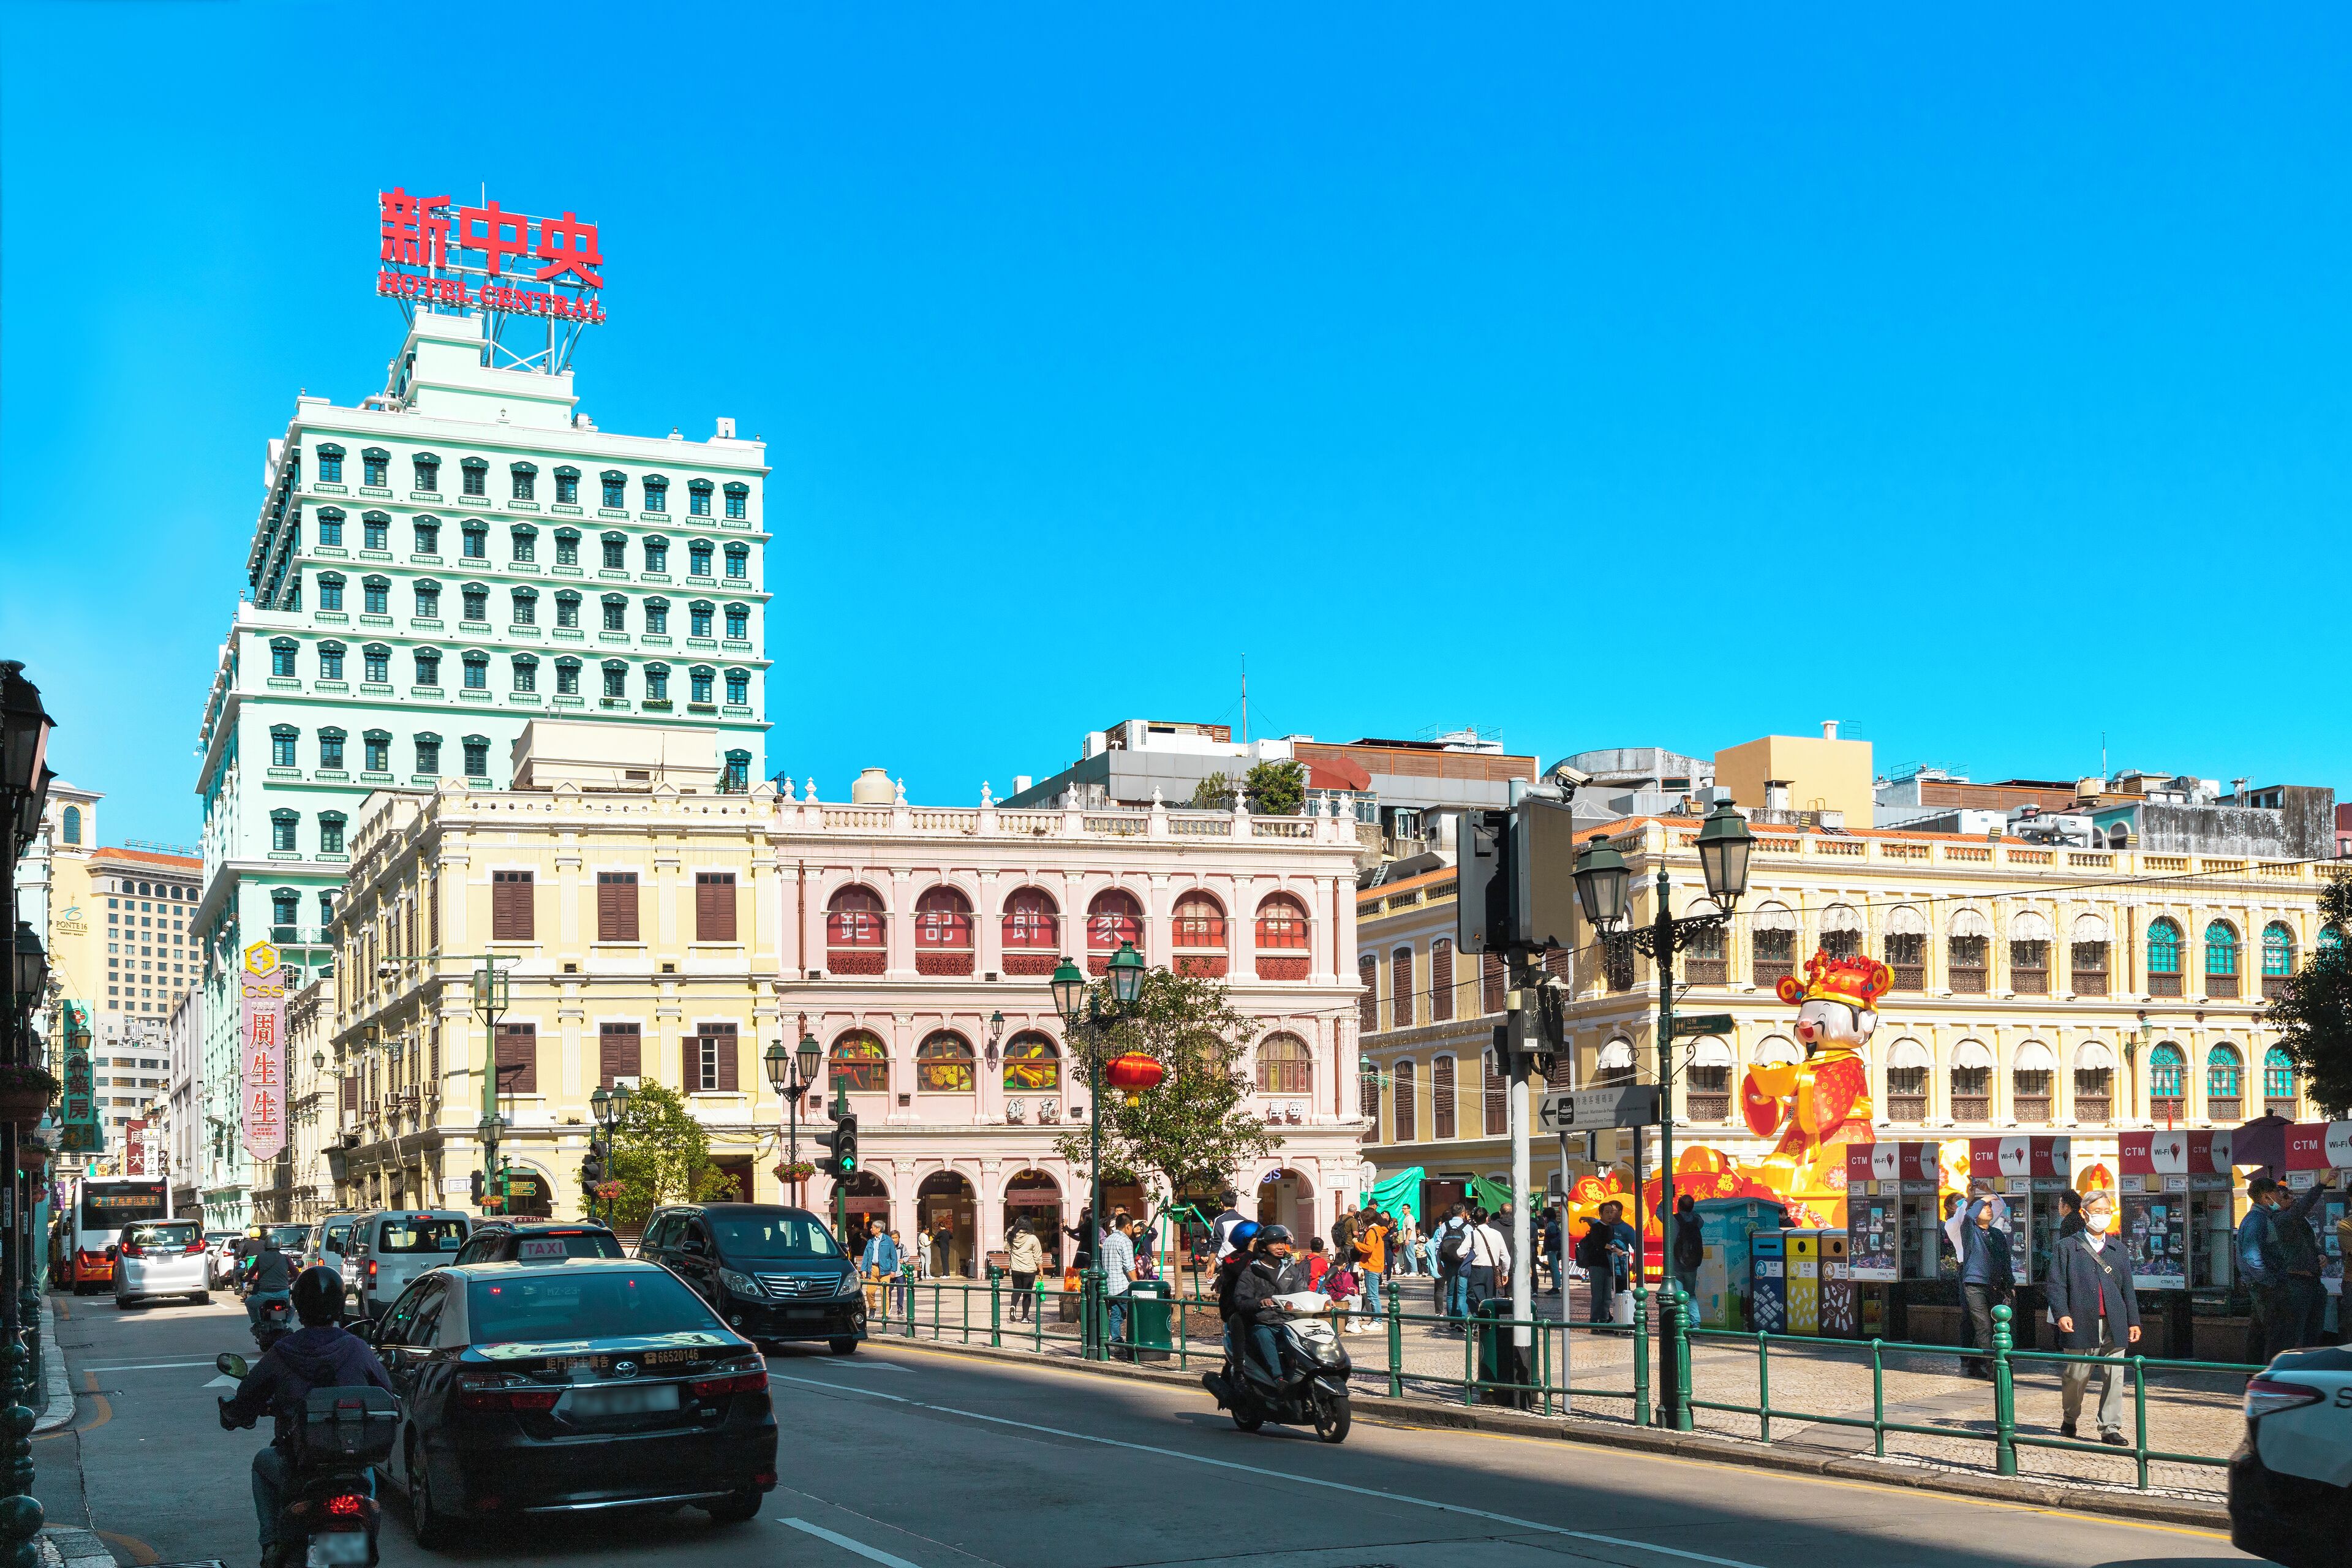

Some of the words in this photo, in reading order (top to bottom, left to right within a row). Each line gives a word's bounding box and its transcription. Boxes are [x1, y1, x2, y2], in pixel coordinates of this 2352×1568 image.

[380, 187, 603, 289] 新中央
[377, 271, 473, 304] HOTEL
[479, 284, 606, 321] CENTRAL
[56, 921, 80, 929] PONTE
[242, 985, 284, 998] CSS
[249, 1012, 278, 1125] 周生生
[2125, 1147, 2145, 1156] CTM
[2293, 1140, 2318, 1150] CTM
[1852, 1156, 1868, 1165] CTM
[1975, 1152, 1993, 1161] CTM
[1609, 1177, 1619, 1193] 福
[1717, 1173, 1734, 1192] 福
[1585, 1183, 1604, 1200] 福
[95, 1196, 102, 1207] 2
[525, 1242, 564, 1255] TAXI
[658, 1348, 699, 1363] 66520146
